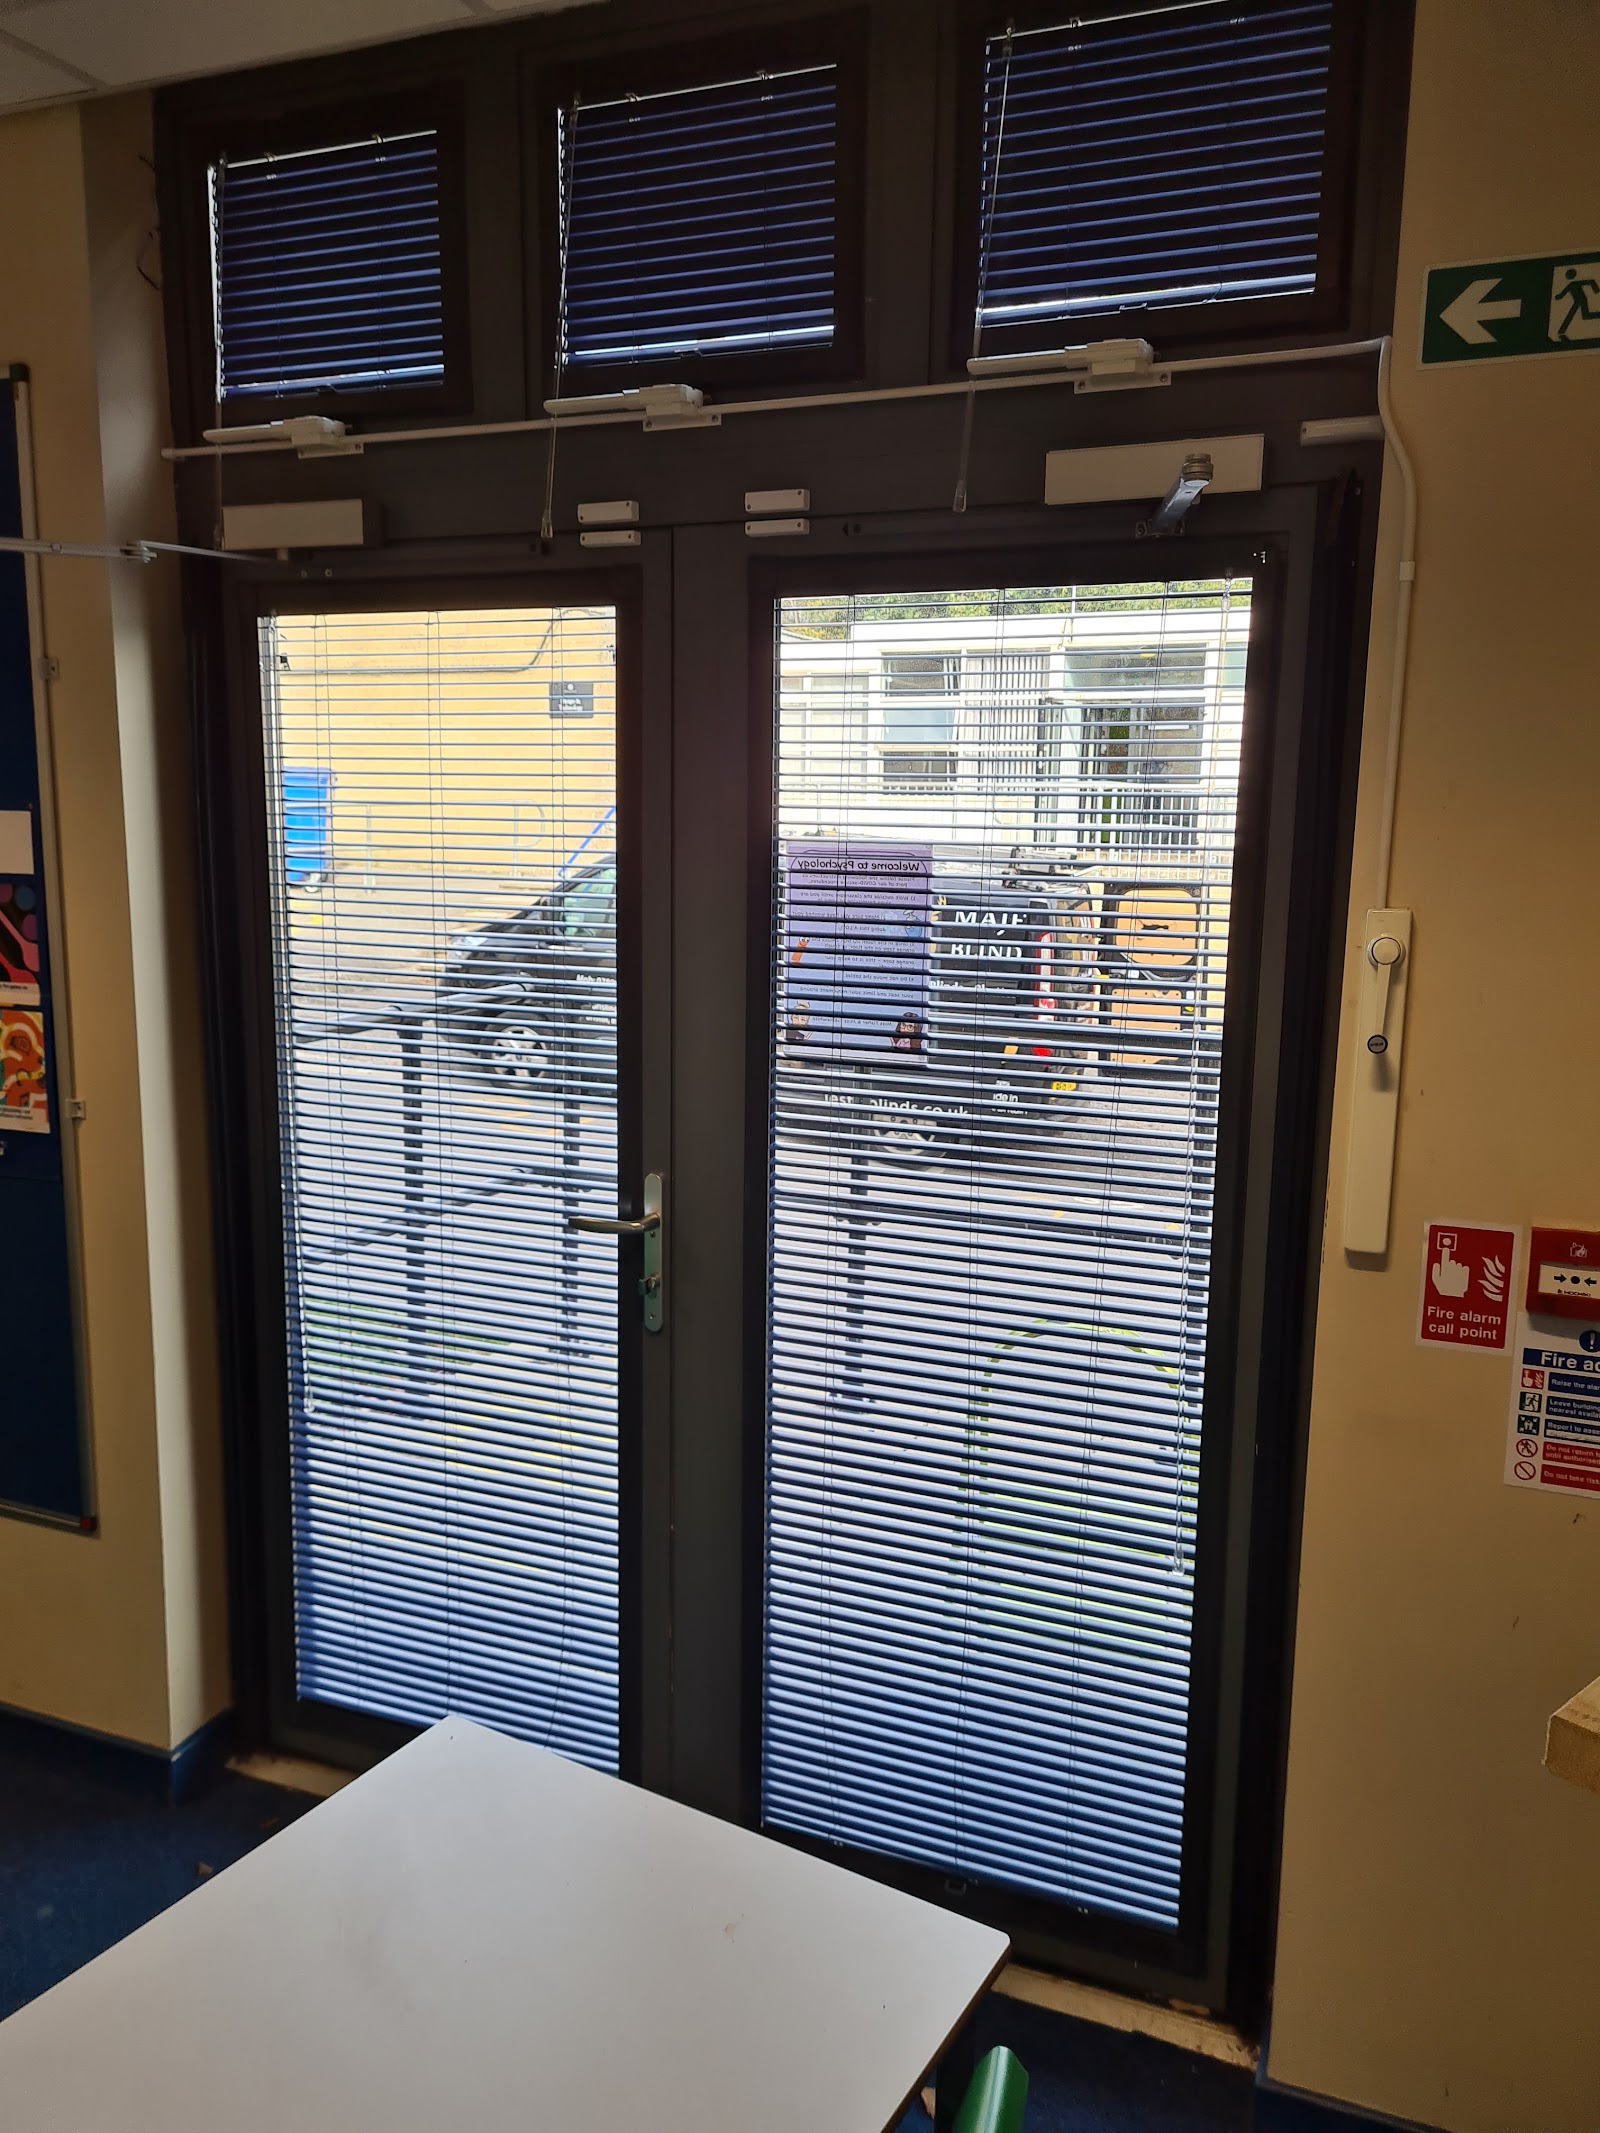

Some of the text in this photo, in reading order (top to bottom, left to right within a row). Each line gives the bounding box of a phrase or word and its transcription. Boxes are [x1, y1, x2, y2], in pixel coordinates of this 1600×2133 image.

[1427, 1305, 1501, 1325] Fire alarm
[1428, 1323, 1497, 1340] call point
[1541, 1351, 1578, 1369] Fire
[1551, 1378, 1572, 1388] Raise
[1573, 1381, 1586, 1389] the
[1549, 1398, 1571, 1408] Leave
[1549, 1406, 1577, 1415] nearest
[1547, 1421, 1573, 1432] Report
[1574, 1425, 1582, 1433] to
[1546, 1444, 1557, 1452] Do
[1558, 1446, 1571, 1454] not
[1543, 1470, 1555, 1479] Do
